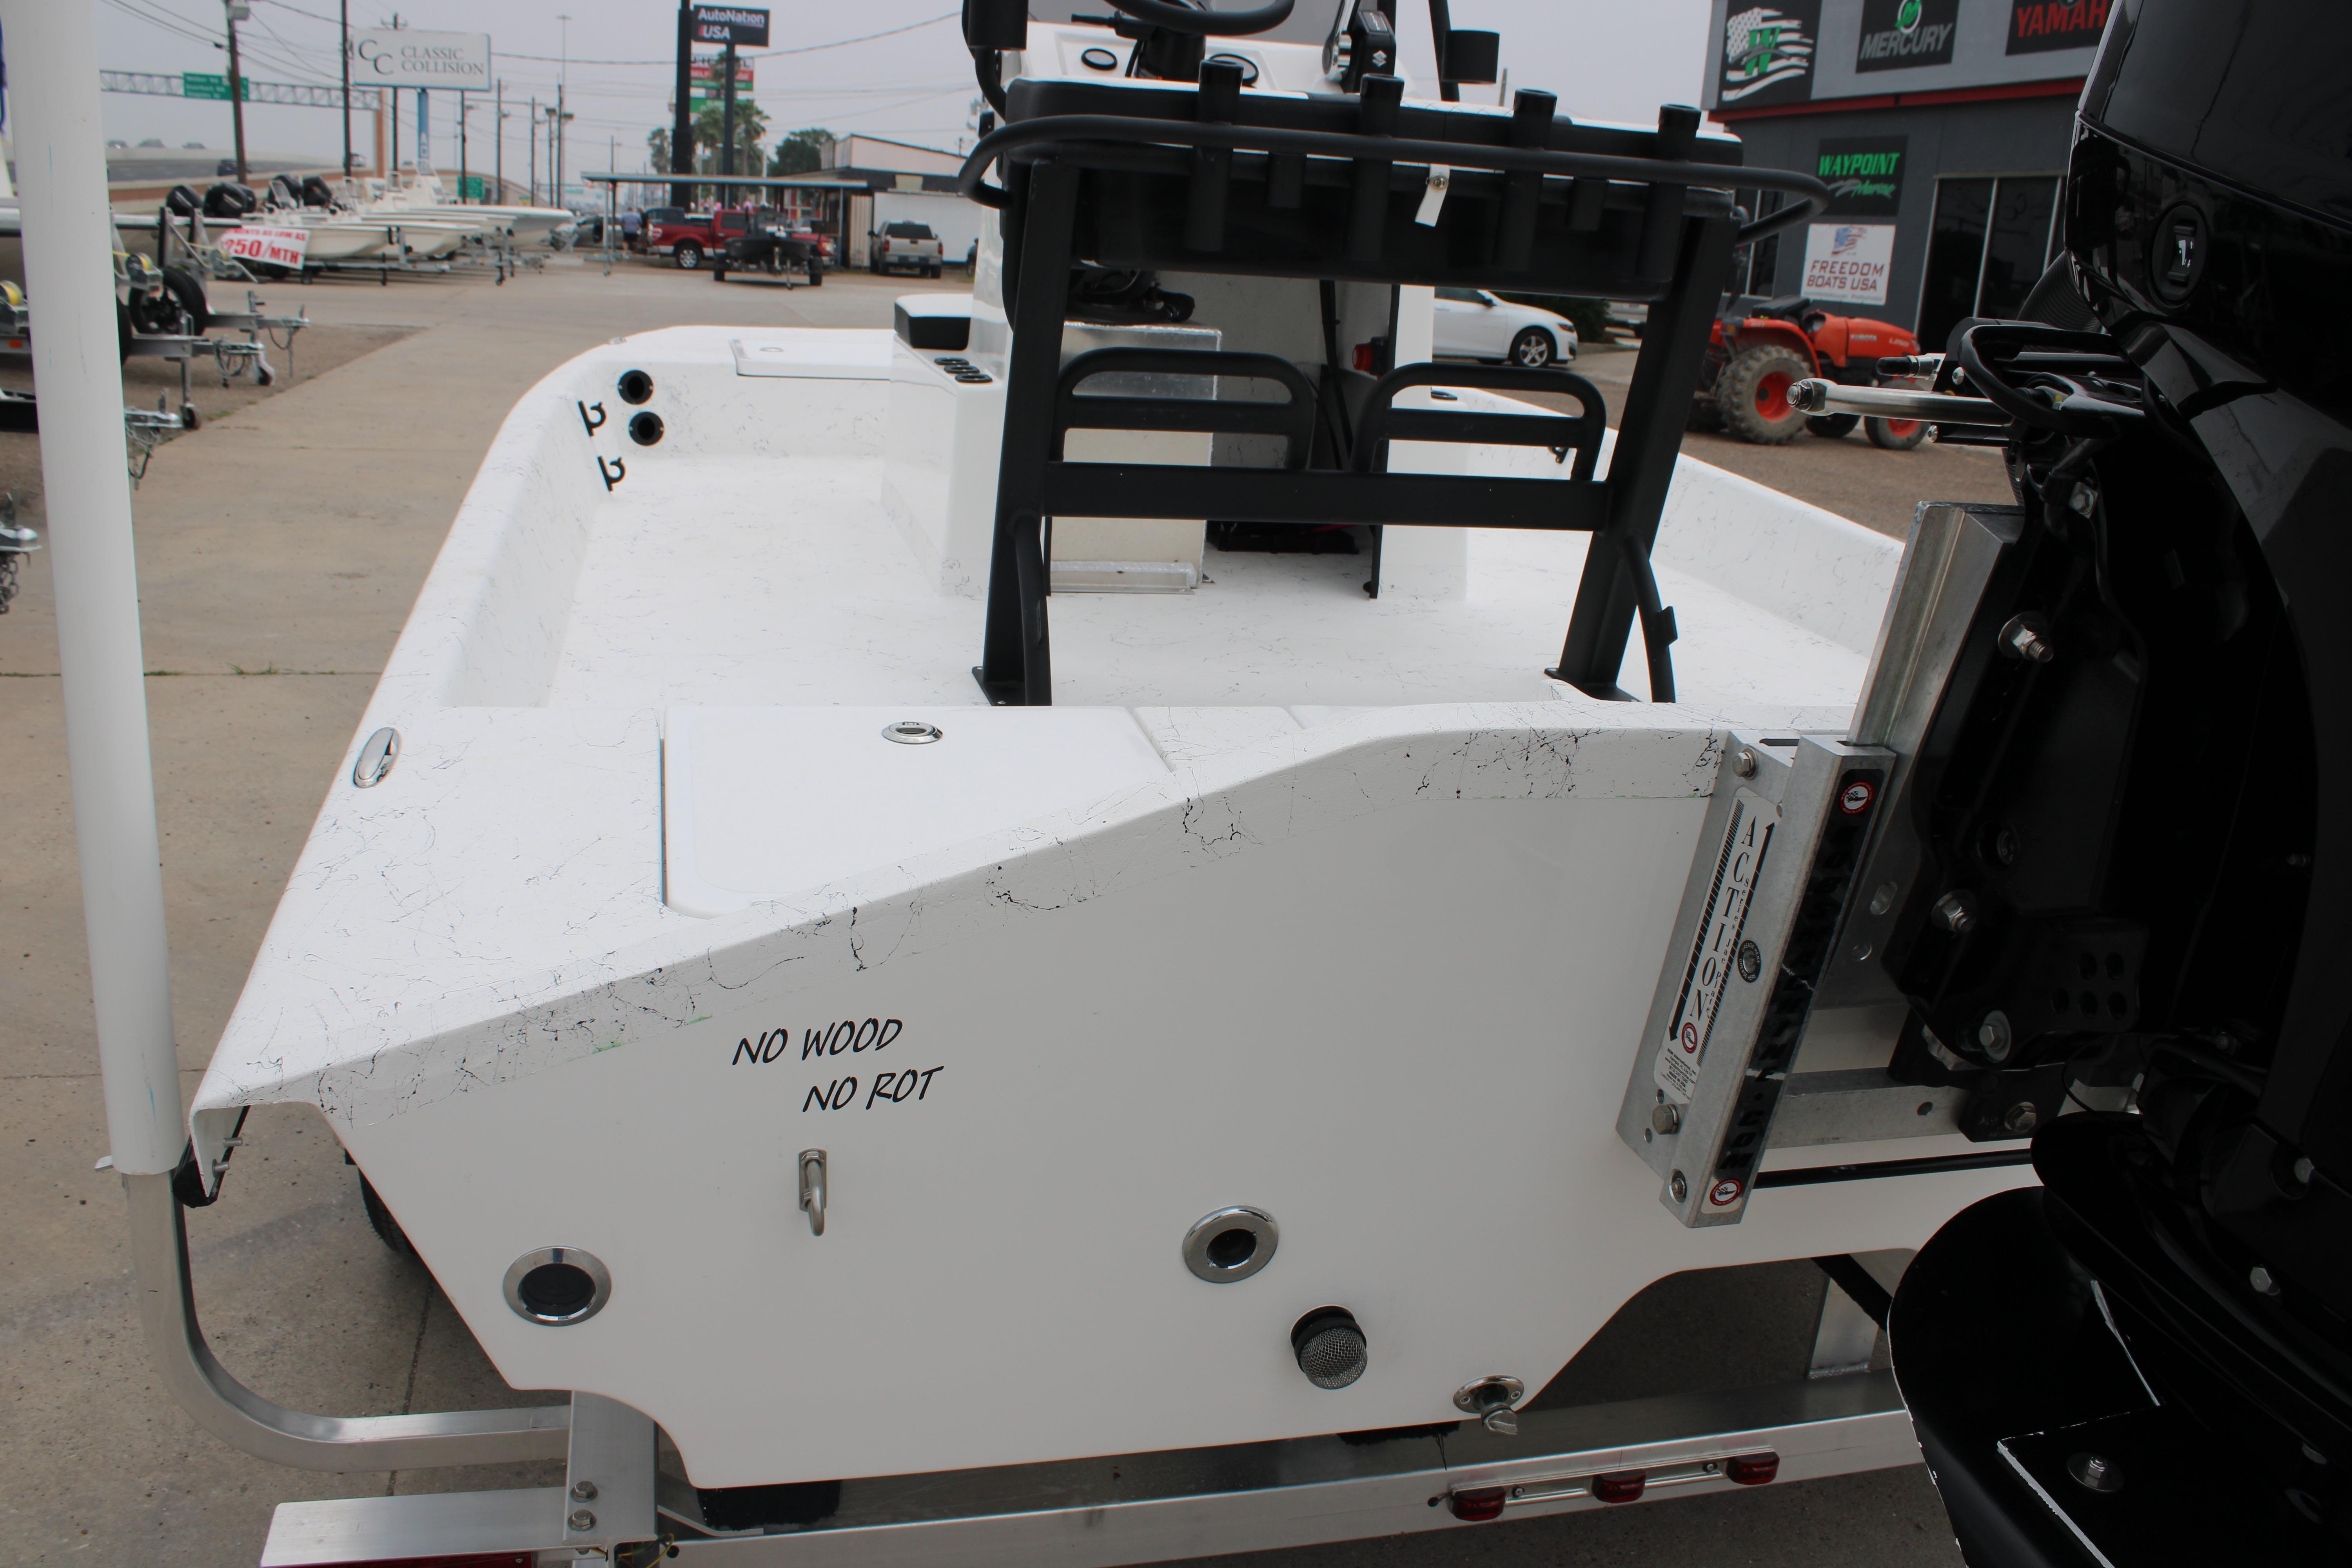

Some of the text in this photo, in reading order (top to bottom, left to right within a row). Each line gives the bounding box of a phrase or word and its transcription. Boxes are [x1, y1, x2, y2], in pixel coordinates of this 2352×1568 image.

[698, 7, 764, 26] AutoNation
[2016, 0, 2106, 37] YAMAH
[703, 25, 730, 40] USA
[1859, 24, 1953, 59] MERCURY
[401, 46, 464, 60] CLASSIC
[401, 60, 484, 75] COLLISION
[1818, 153, 1900, 176] WAYPOINT
[1811, 260, 1884, 276] FREEDOM
[1807, 276, 1877, 291] BOATS USA
[1731, 878, 1749, 930] Series
[1689, 815, 1756, 1021] ACTION
[1721, 938, 1731, 964] Jac
[732, 1018, 903, 1065] NO WOOD
[802, 1065, 944, 1112] NO ROT
